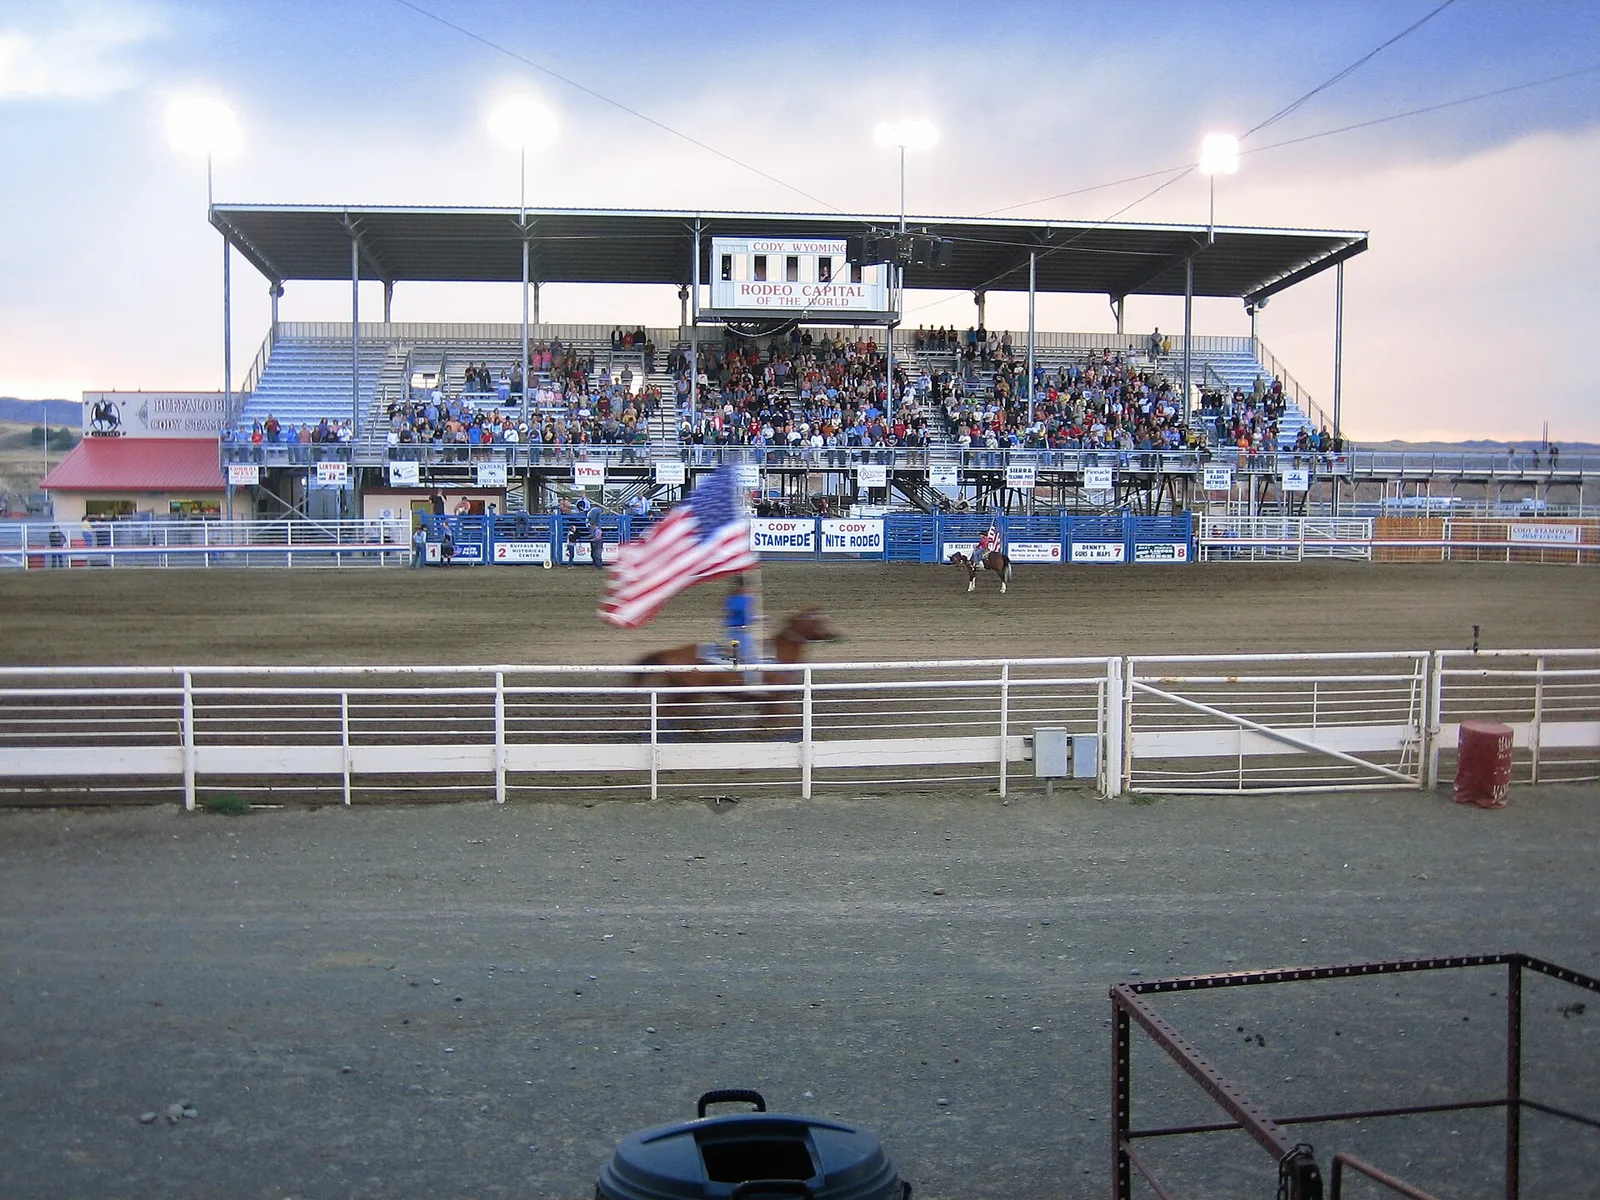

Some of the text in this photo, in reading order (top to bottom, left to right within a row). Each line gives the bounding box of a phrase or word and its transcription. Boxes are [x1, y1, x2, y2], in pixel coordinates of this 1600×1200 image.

[793, 243, 847, 252] WYOMING
[741, 284, 865, 297] RODEO CAPITAL
[757, 297, 849, 307] OF THE WORLD
[154, 399, 211, 413] BUFFALO
[151, 419, 181, 431] CODY
[768, 523, 797, 531] CODY
[839, 524, 867, 532] CODY
[754, 532, 811, 546] STAMPEDE
[825, 533, 880, 547] NITE RODEO
[430, 548, 436, 558] 1
[498, 547, 506, 558] 2
[1051, 547, 1059, 557] 6
[1114, 548, 1121, 557] 7
[1177, 548, 1185, 558] 8
